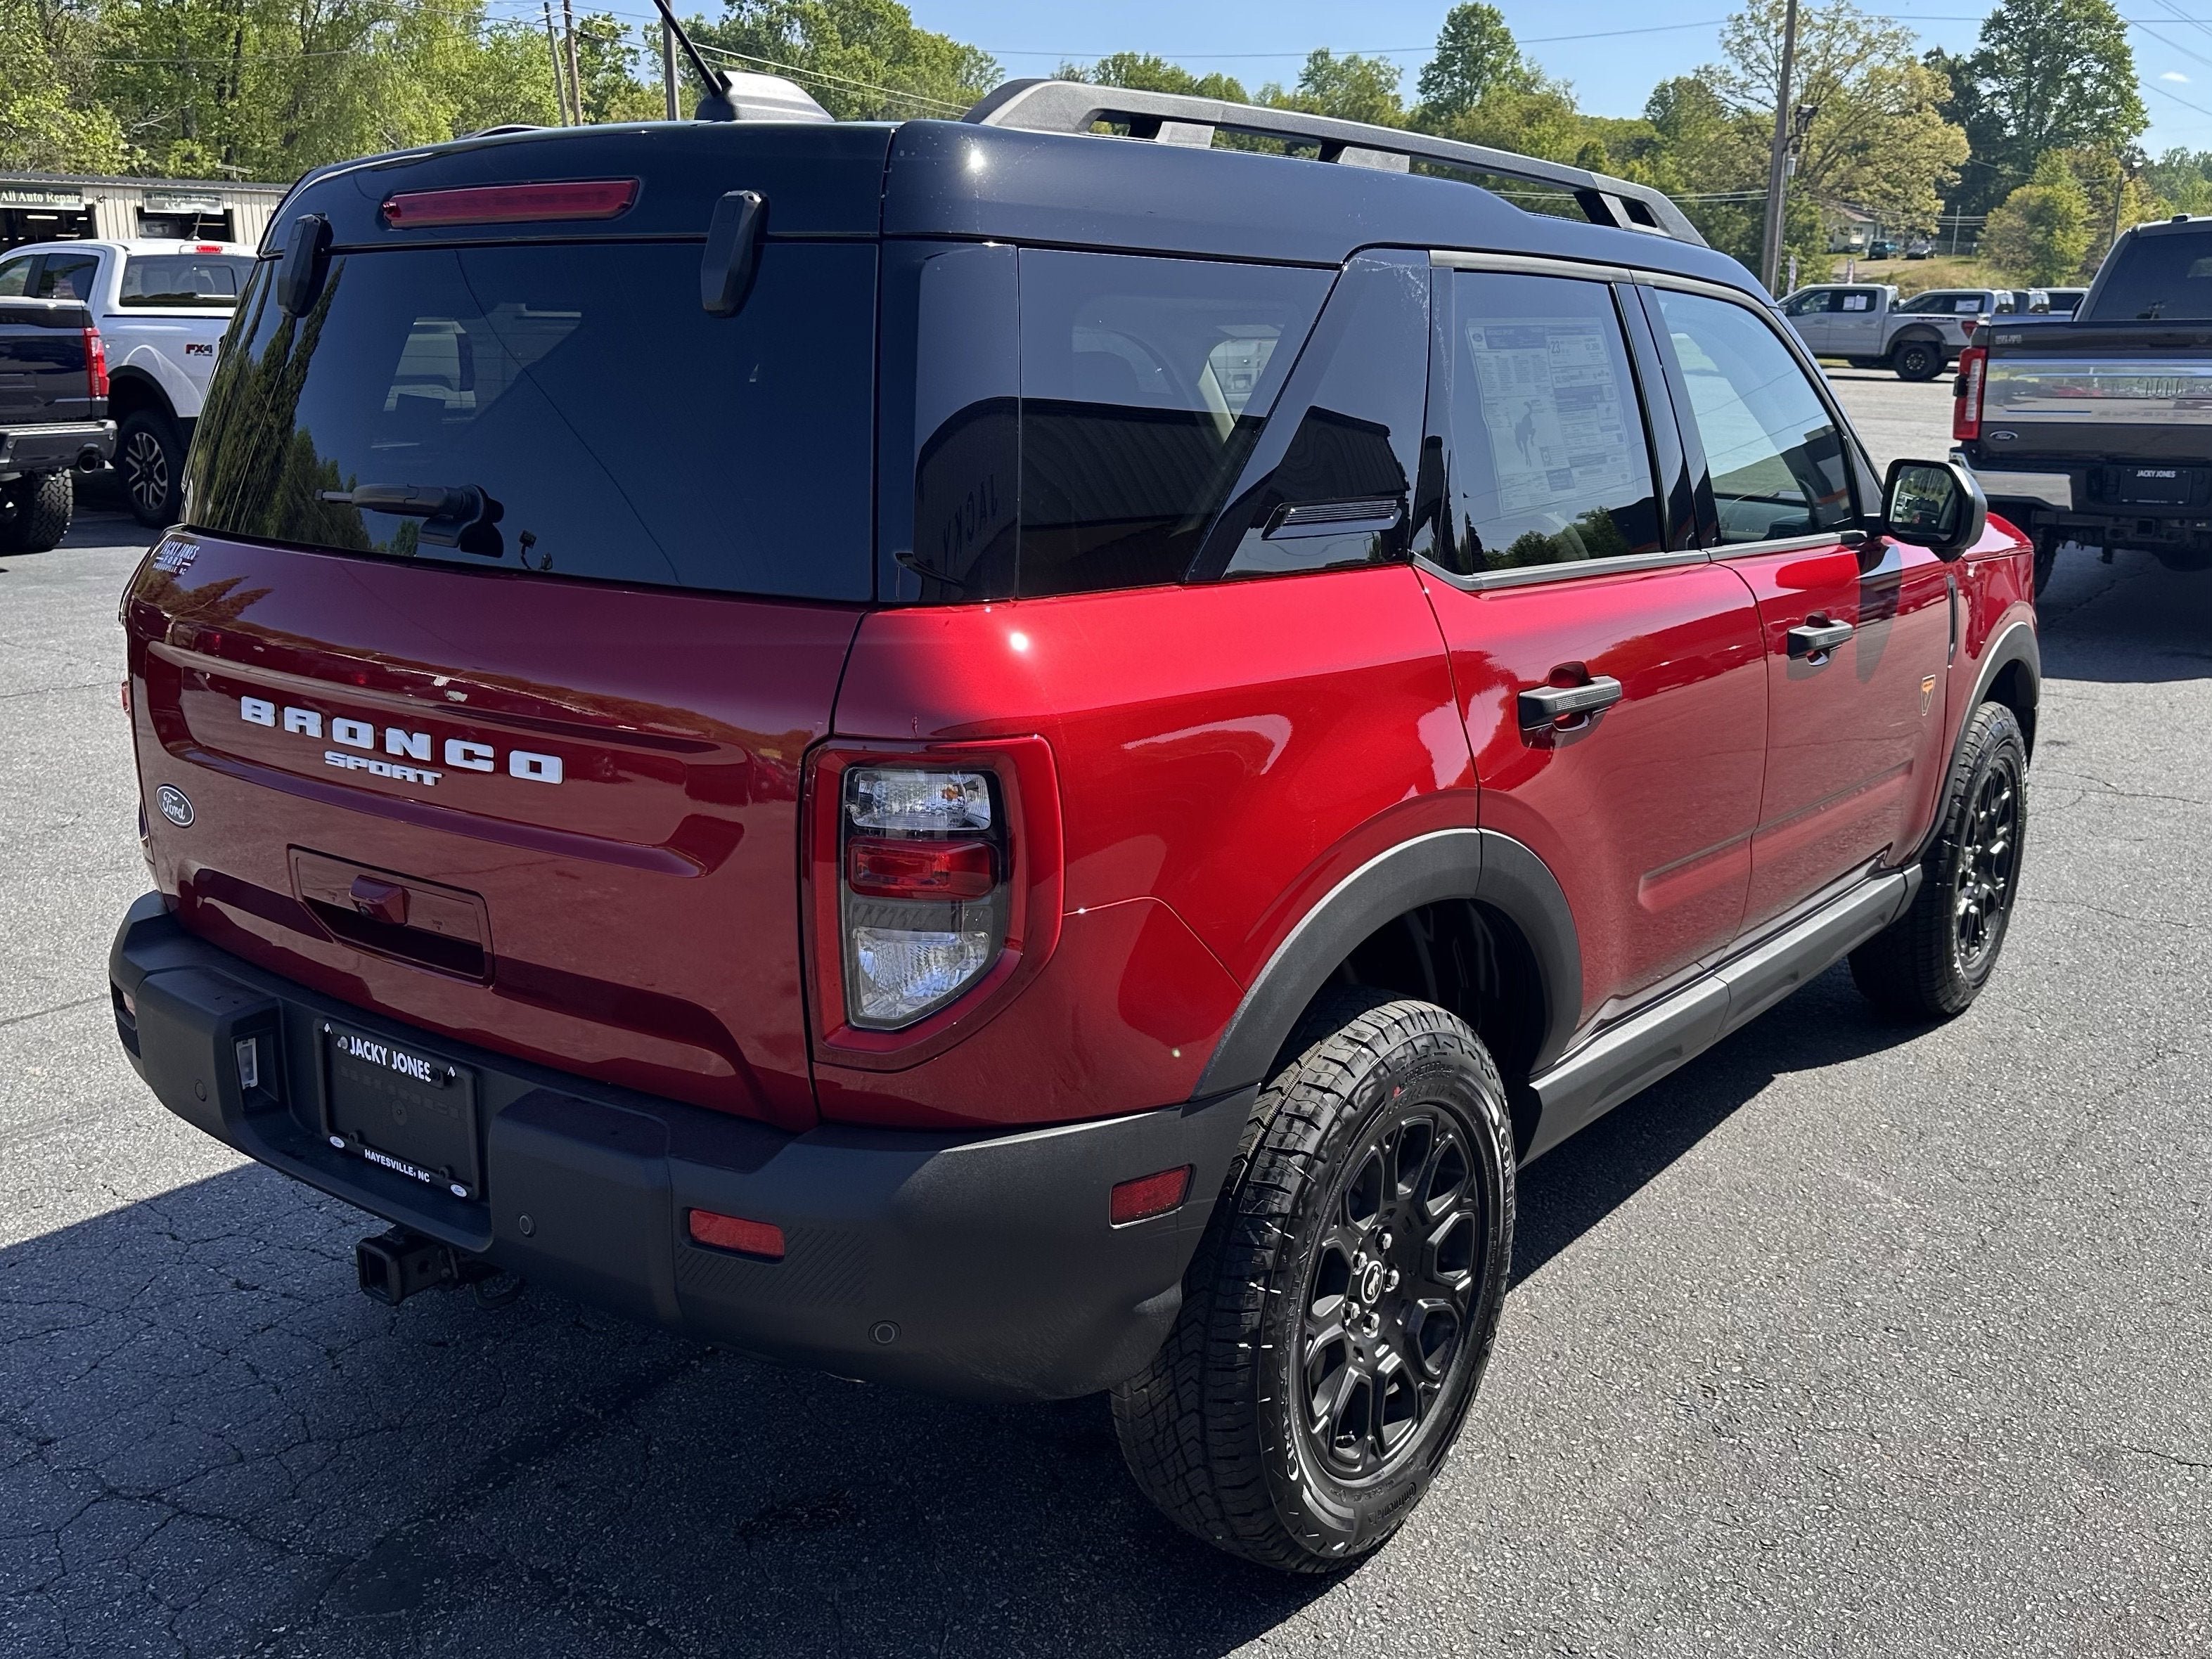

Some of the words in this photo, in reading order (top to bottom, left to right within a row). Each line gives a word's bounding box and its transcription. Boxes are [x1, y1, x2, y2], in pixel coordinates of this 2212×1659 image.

[1, 191, 16, 202] All
[18, 191, 44, 202] Auto
[46, 192, 80, 206] Repair
[186, 344, 213, 354] FX4
[163, 555, 183, 566] FORD
[240, 695, 563, 785] BRONCO
[324, 750, 443, 786] SPORT
[162, 791, 186, 820] Ford
[349, 1036, 387, 1066] JACKY
[392, 1050, 432, 1082] JONES
[418, 1170, 430, 1182] NC
